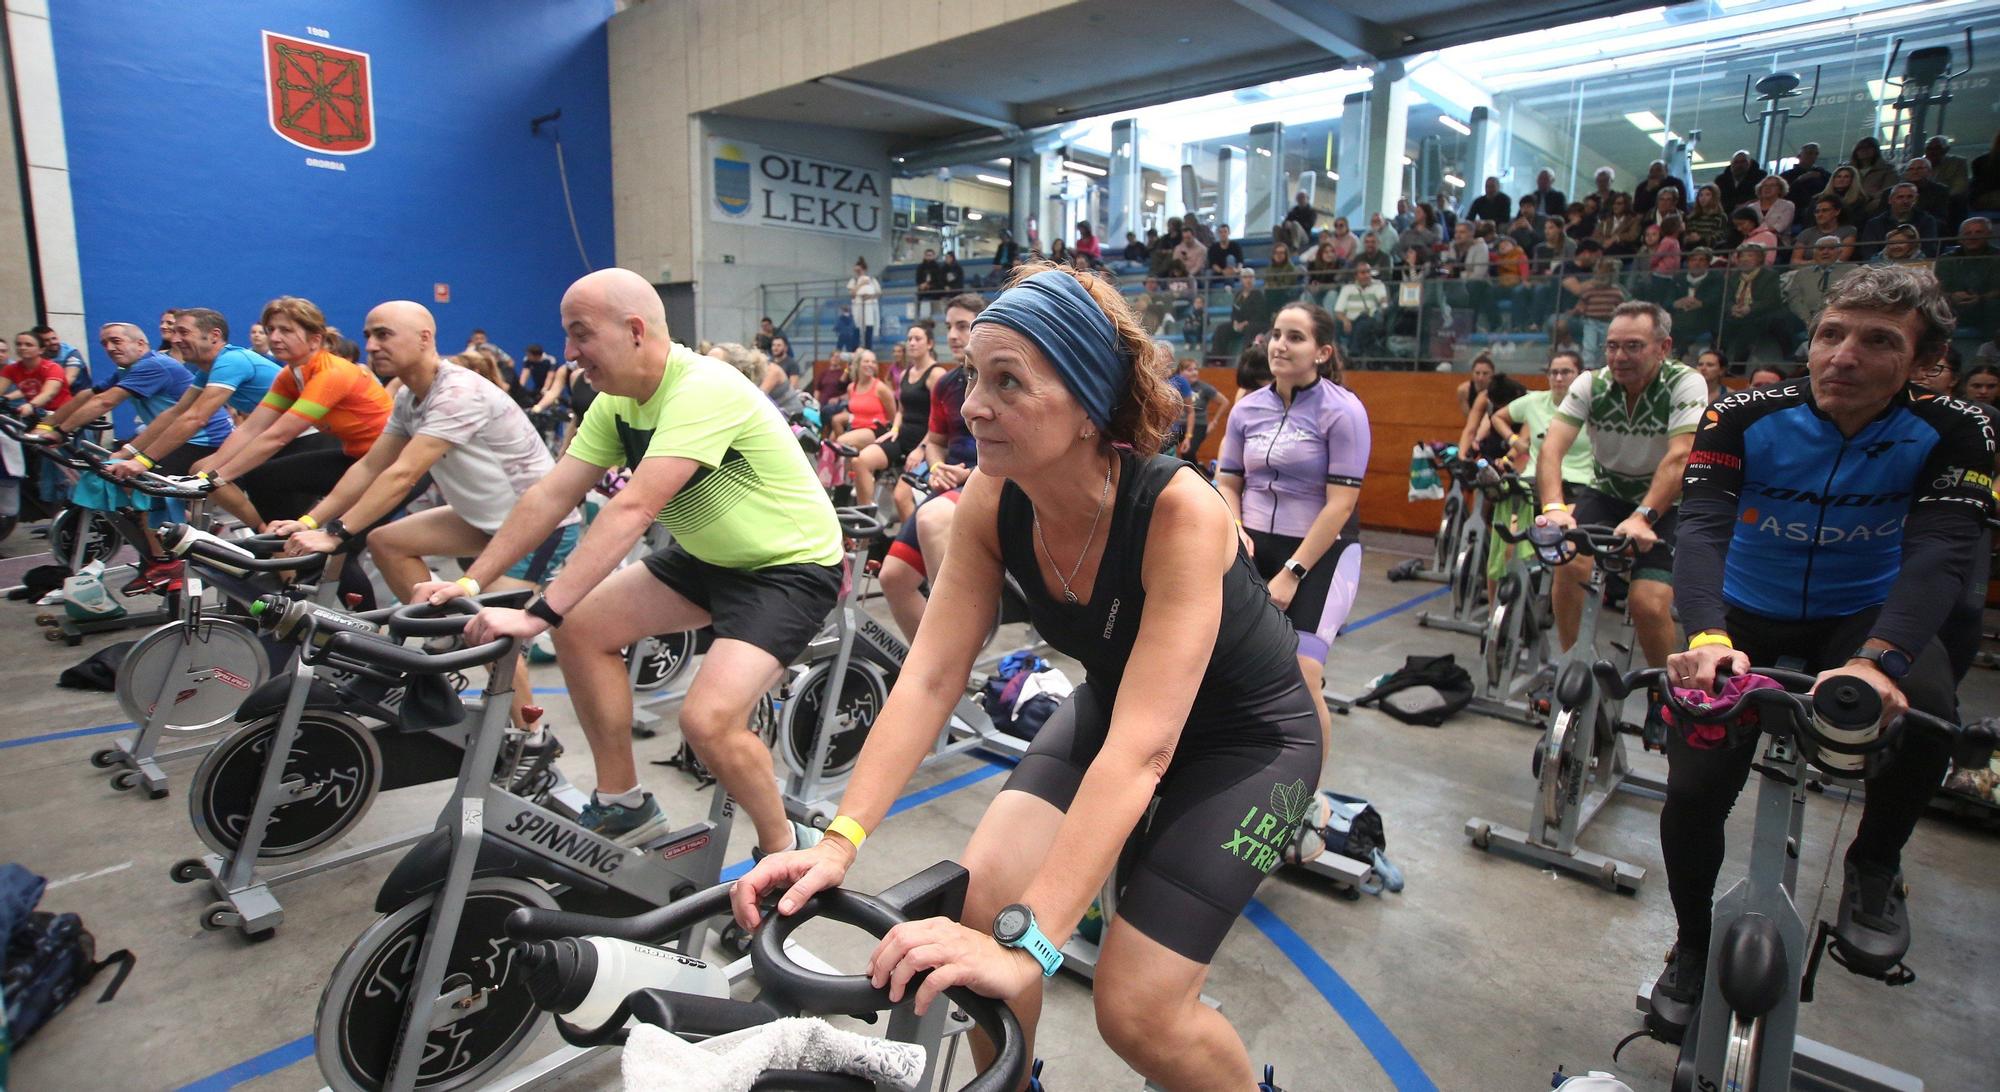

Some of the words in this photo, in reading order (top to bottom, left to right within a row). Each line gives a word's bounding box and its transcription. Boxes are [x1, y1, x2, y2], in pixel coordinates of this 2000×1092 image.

[760, 154, 880, 198] OLTZA
[761, 188, 880, 233] LEKU
[1713, 385, 1799, 413] ASPACE
[1760, 514, 1909, 546] ASPAC
[861, 620, 909, 661] SPINNIN
[1103, 598, 1121, 640] ETXEONDO
[505, 810, 625, 875] SPINNING
[1240, 806, 1295, 849] IRA
[1221, 829, 1279, 874] XTRE
